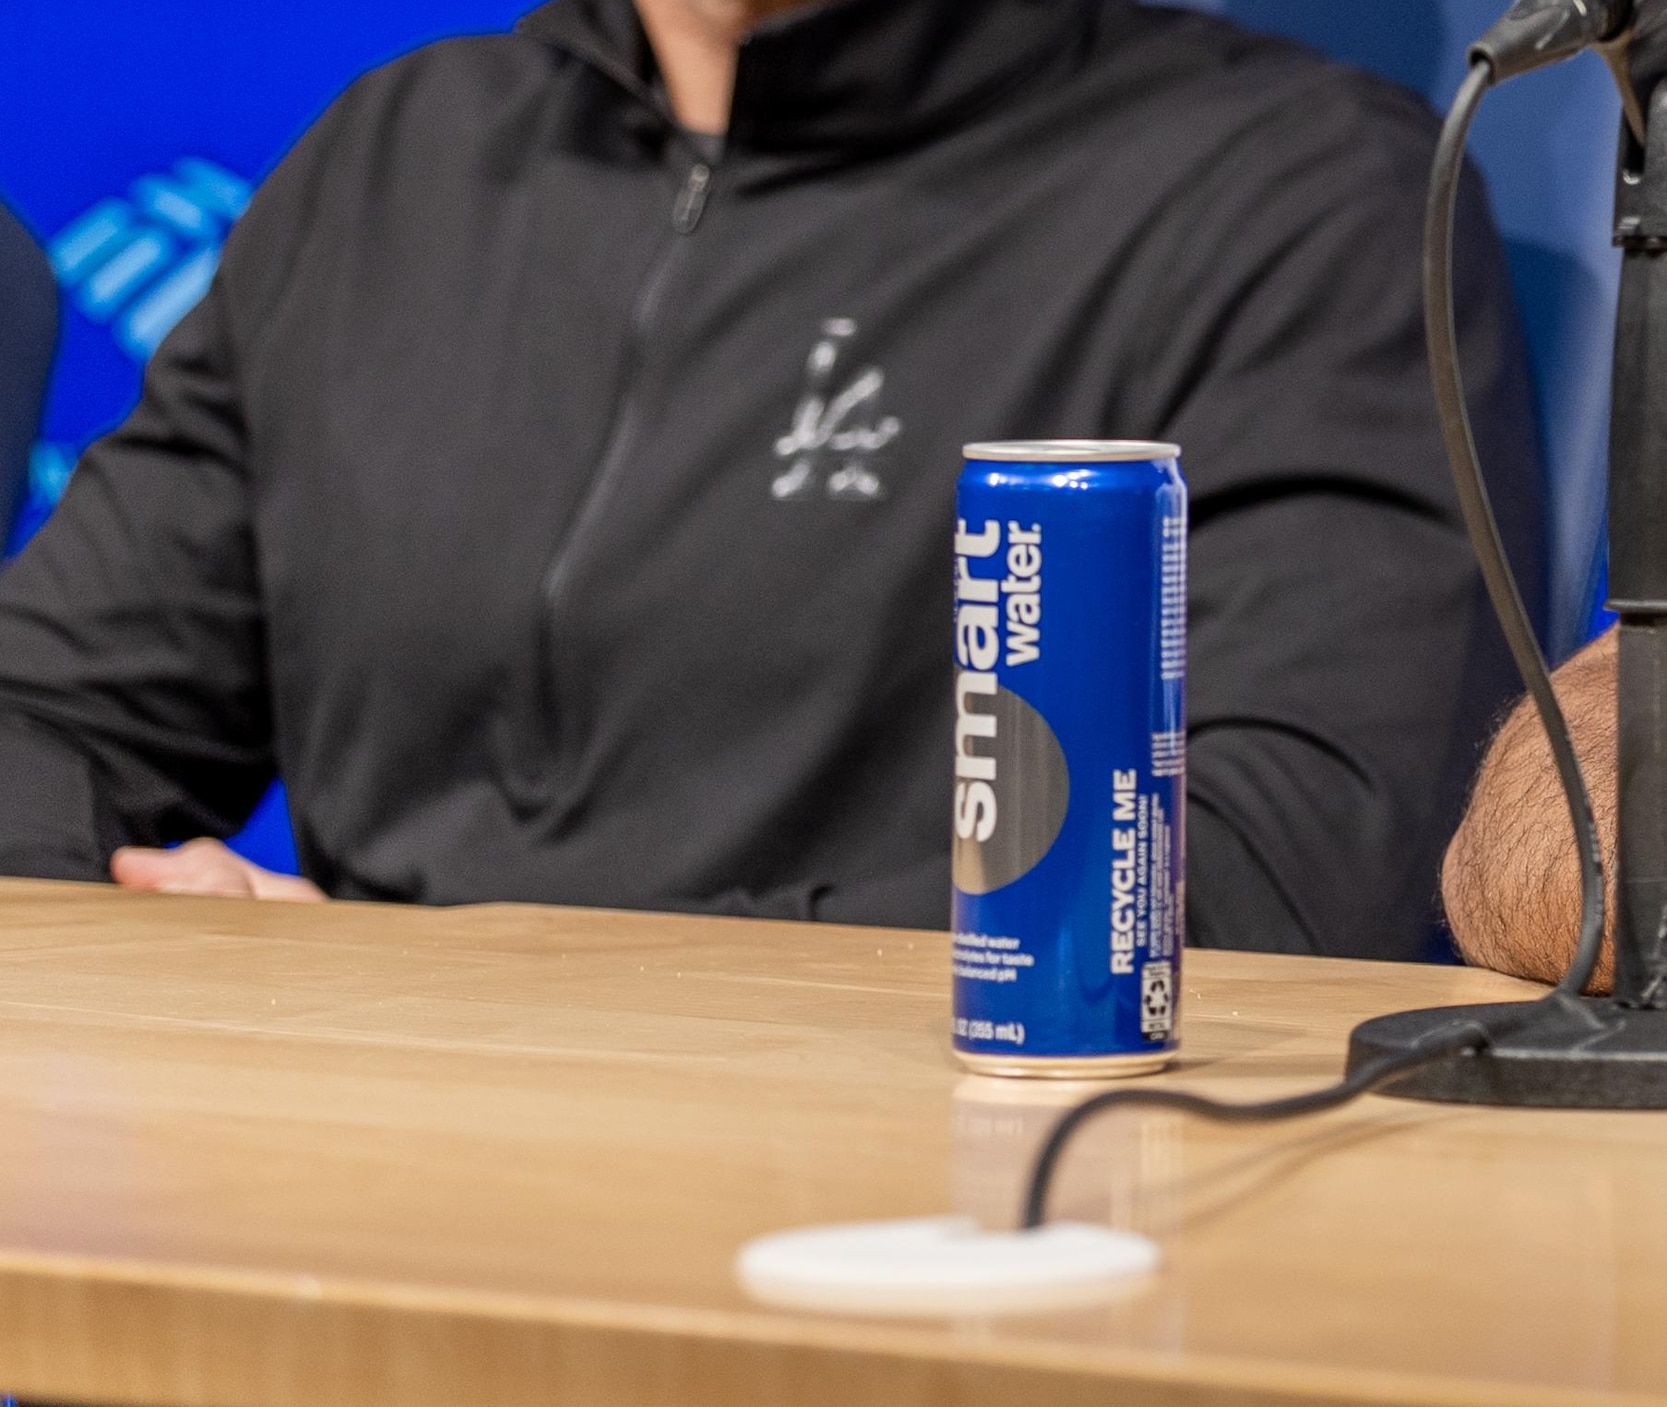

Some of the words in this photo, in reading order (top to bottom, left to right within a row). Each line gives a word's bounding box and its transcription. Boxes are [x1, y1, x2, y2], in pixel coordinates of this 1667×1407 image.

[954, 520, 1001, 843] smart
[1112, 768, 1137, 821] ME
[1137, 841, 1148, 885] AGAIN
[1110, 827, 1136, 974] RECYCLE
[1136, 887, 1148, 918] YOU
[1136, 919, 1147, 947] SEE
